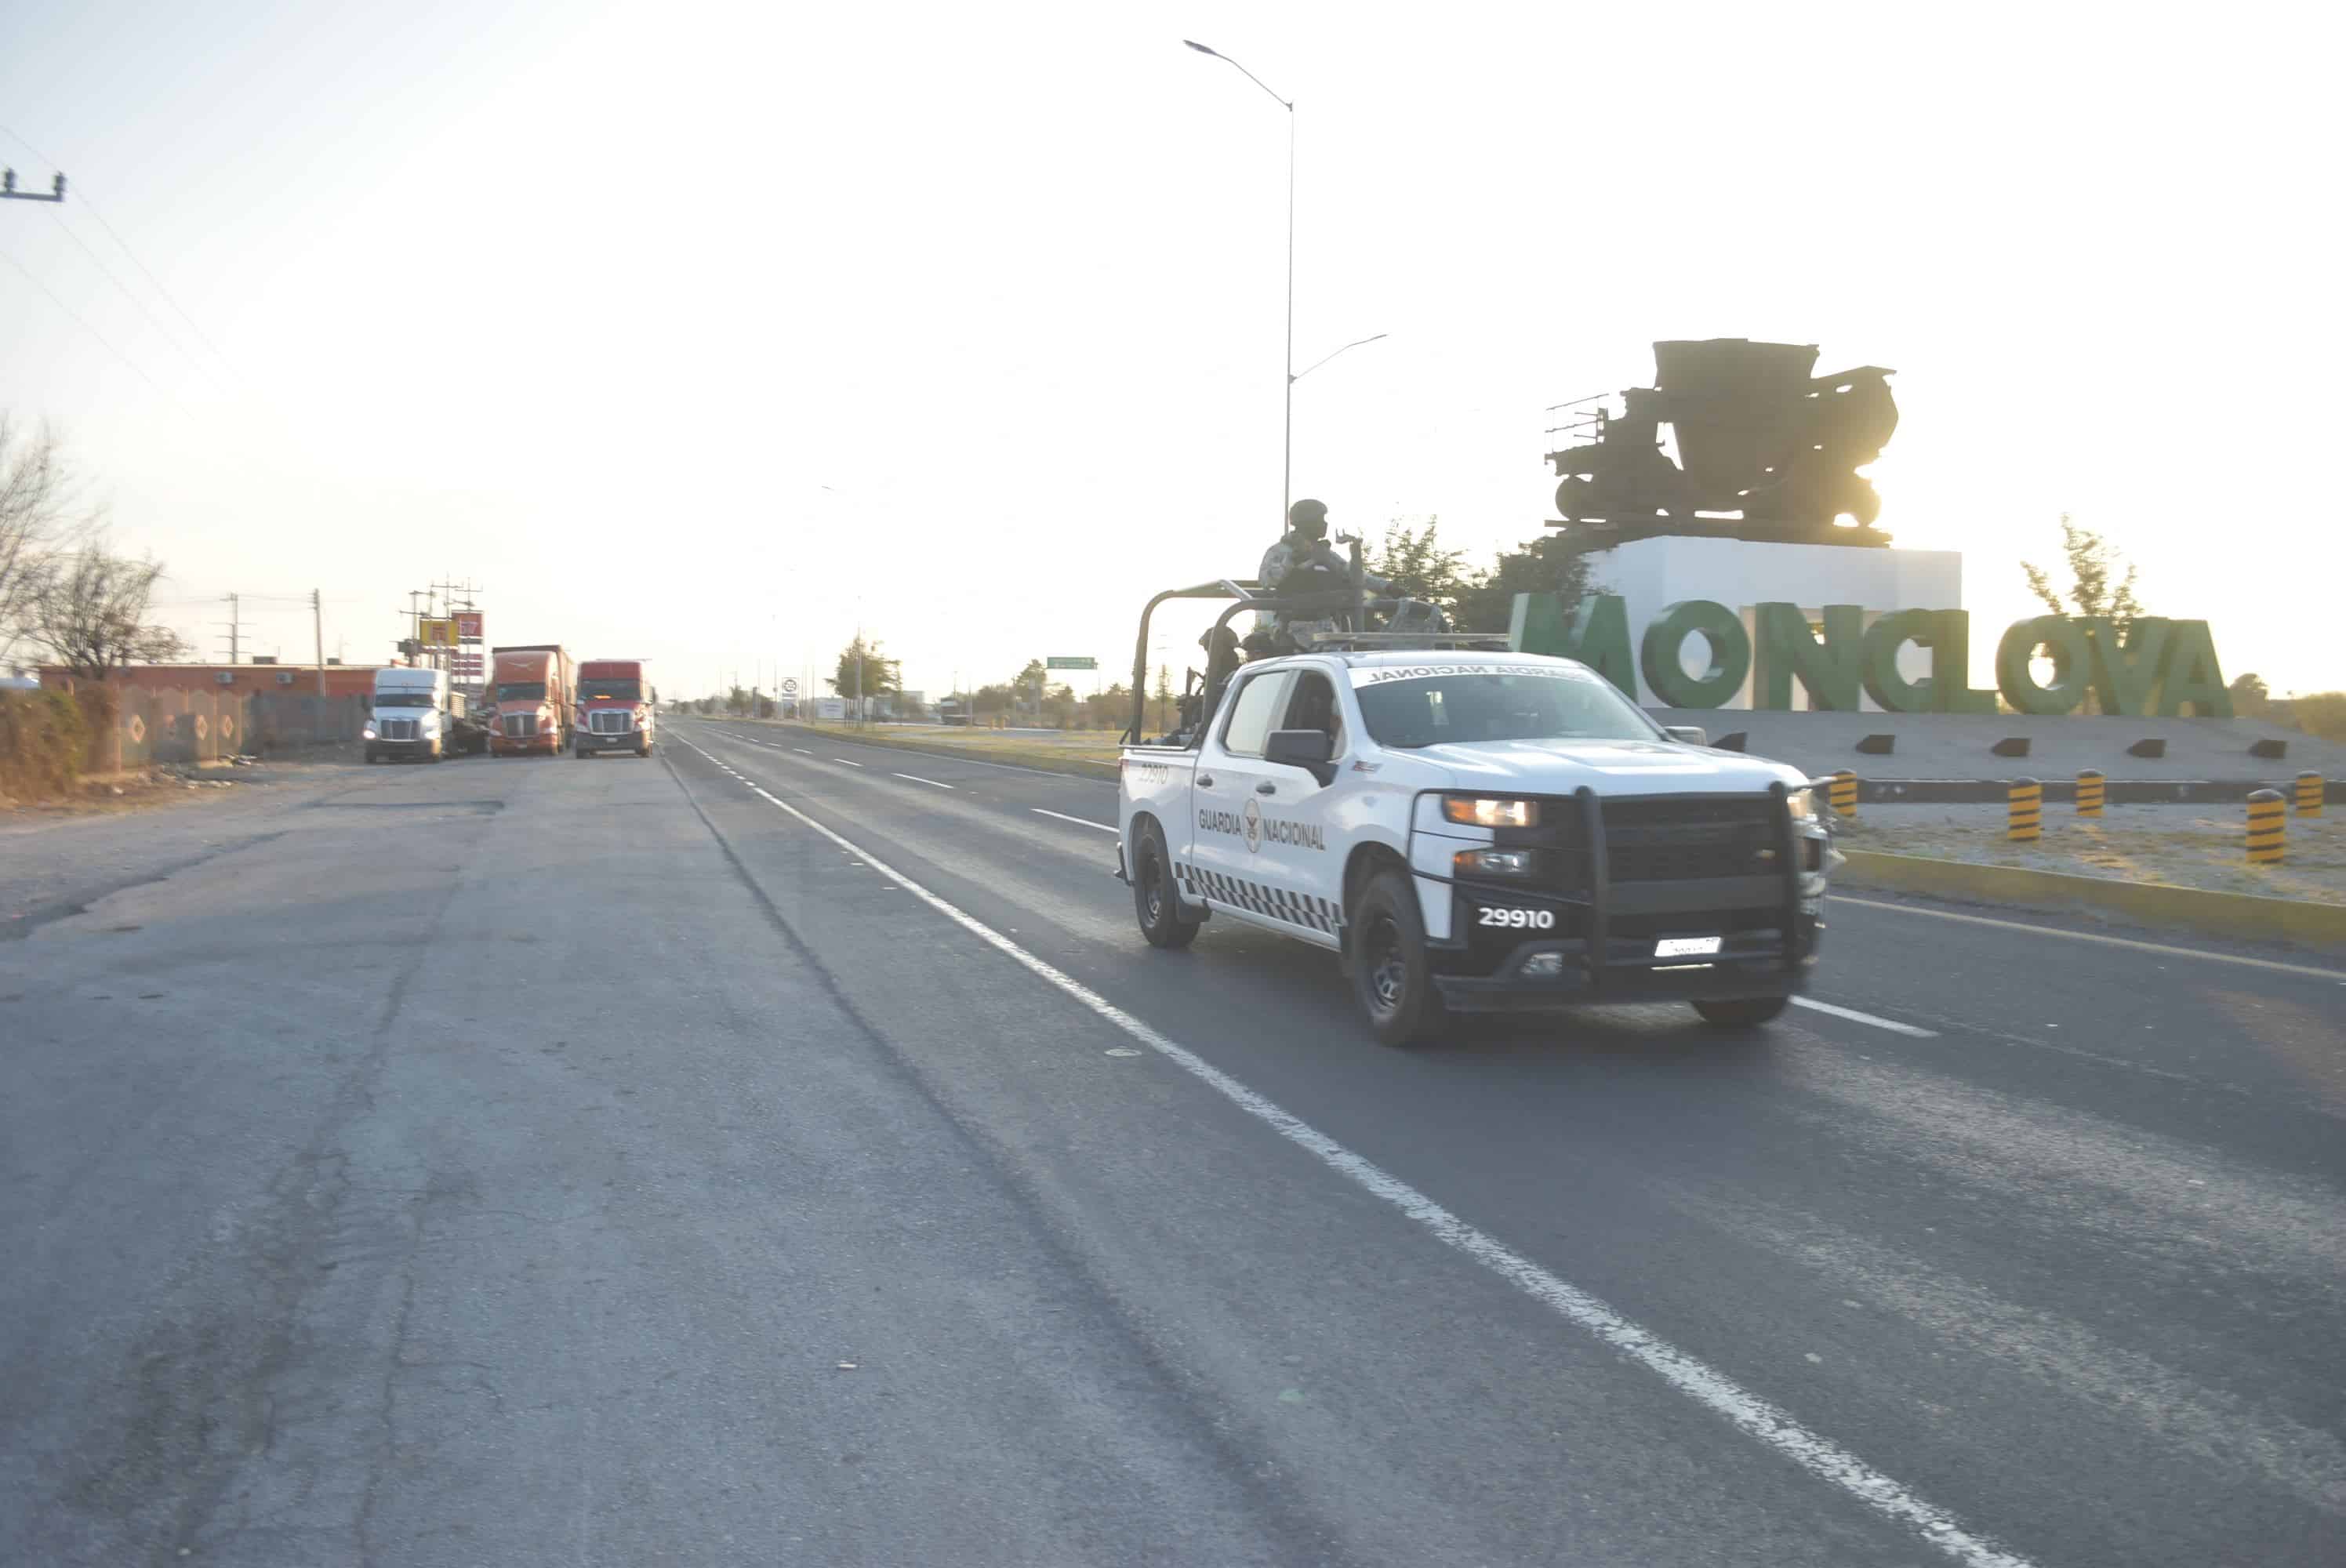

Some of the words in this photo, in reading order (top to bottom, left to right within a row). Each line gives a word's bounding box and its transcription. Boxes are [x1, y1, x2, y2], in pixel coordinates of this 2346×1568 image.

[1509, 593, 2234, 717] MONCLOVA
[1198, 808, 1243, 837] GUARDIA
[1262, 818, 1327, 851] NACIONAL
[1478, 906, 1556, 929] 29910
